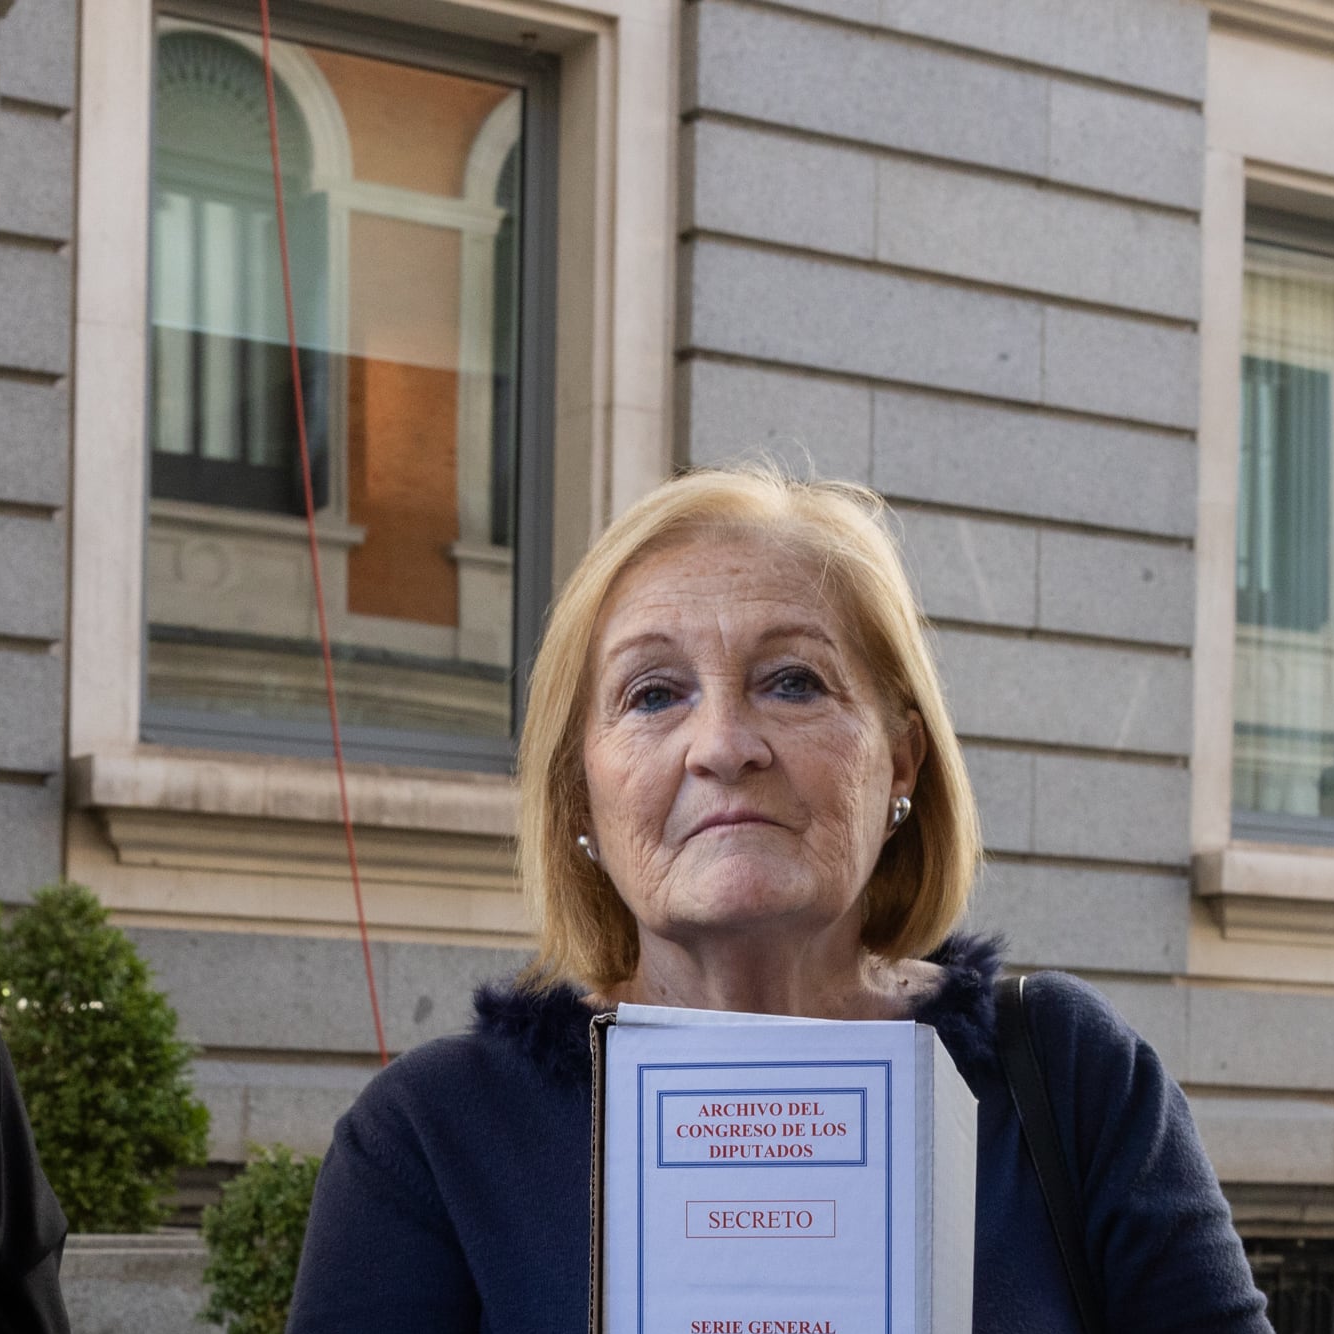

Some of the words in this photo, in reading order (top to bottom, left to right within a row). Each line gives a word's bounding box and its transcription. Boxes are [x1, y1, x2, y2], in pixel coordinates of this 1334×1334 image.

[698, 1102, 783, 1117] ARCHIVO
[788, 1102, 824, 1116] DEL
[676, 1123, 777, 1138] CONGRESO
[782, 1123, 806, 1137] DE
[811, 1122, 847, 1137] LOS
[709, 1144, 813, 1159] DIPUTADOS
[708, 1210, 813, 1229] SECRETO
[691, 1320, 743, 1334] SERIE
[748, 1320, 836, 1334] GENERAL
